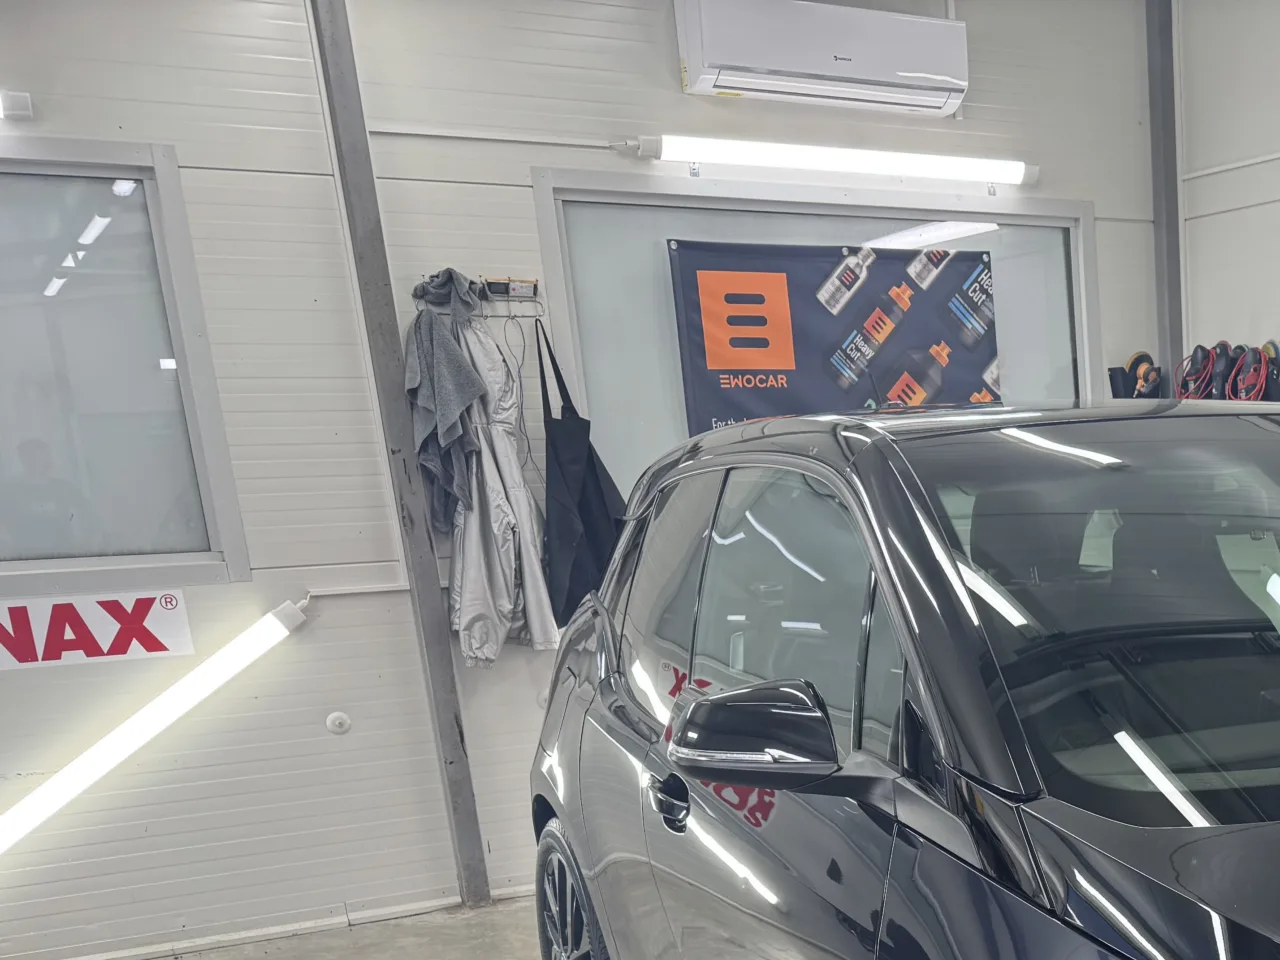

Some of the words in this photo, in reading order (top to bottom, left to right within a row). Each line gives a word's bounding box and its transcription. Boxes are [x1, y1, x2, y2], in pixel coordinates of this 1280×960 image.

[968, 282, 987, 306] Cut
[846, 343, 861, 361] Cut
[853, 333, 875, 360] Heavy
[719, 374, 788, 388] EWOCAR
